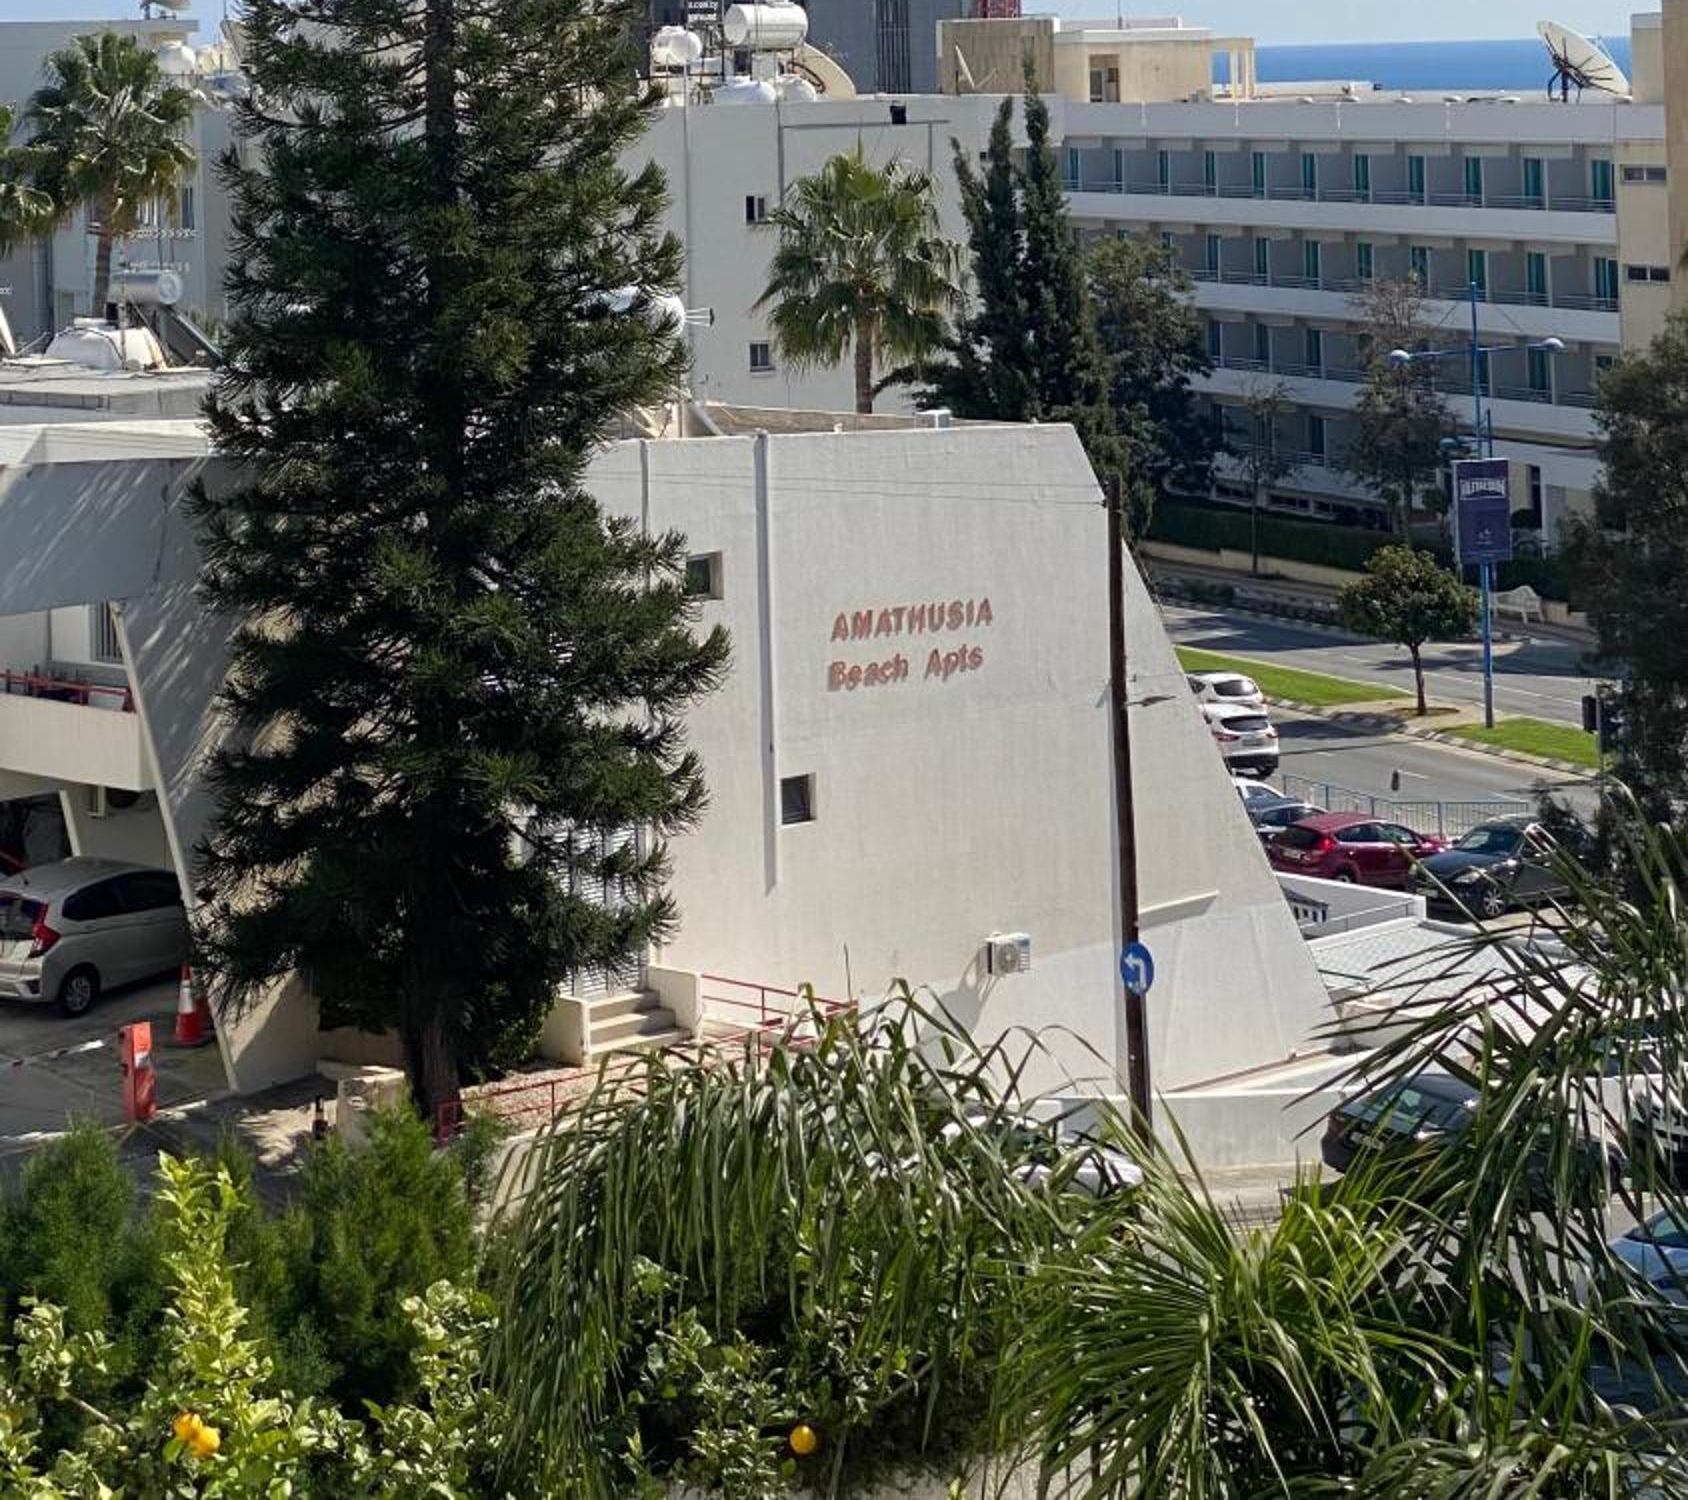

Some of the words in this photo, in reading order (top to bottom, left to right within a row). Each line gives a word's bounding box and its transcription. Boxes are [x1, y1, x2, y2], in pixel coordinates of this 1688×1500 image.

[830, 597, 994, 642] AMATHUSIA
[827, 652, 910, 692] Beach
[924, 643, 985, 683] Apts
